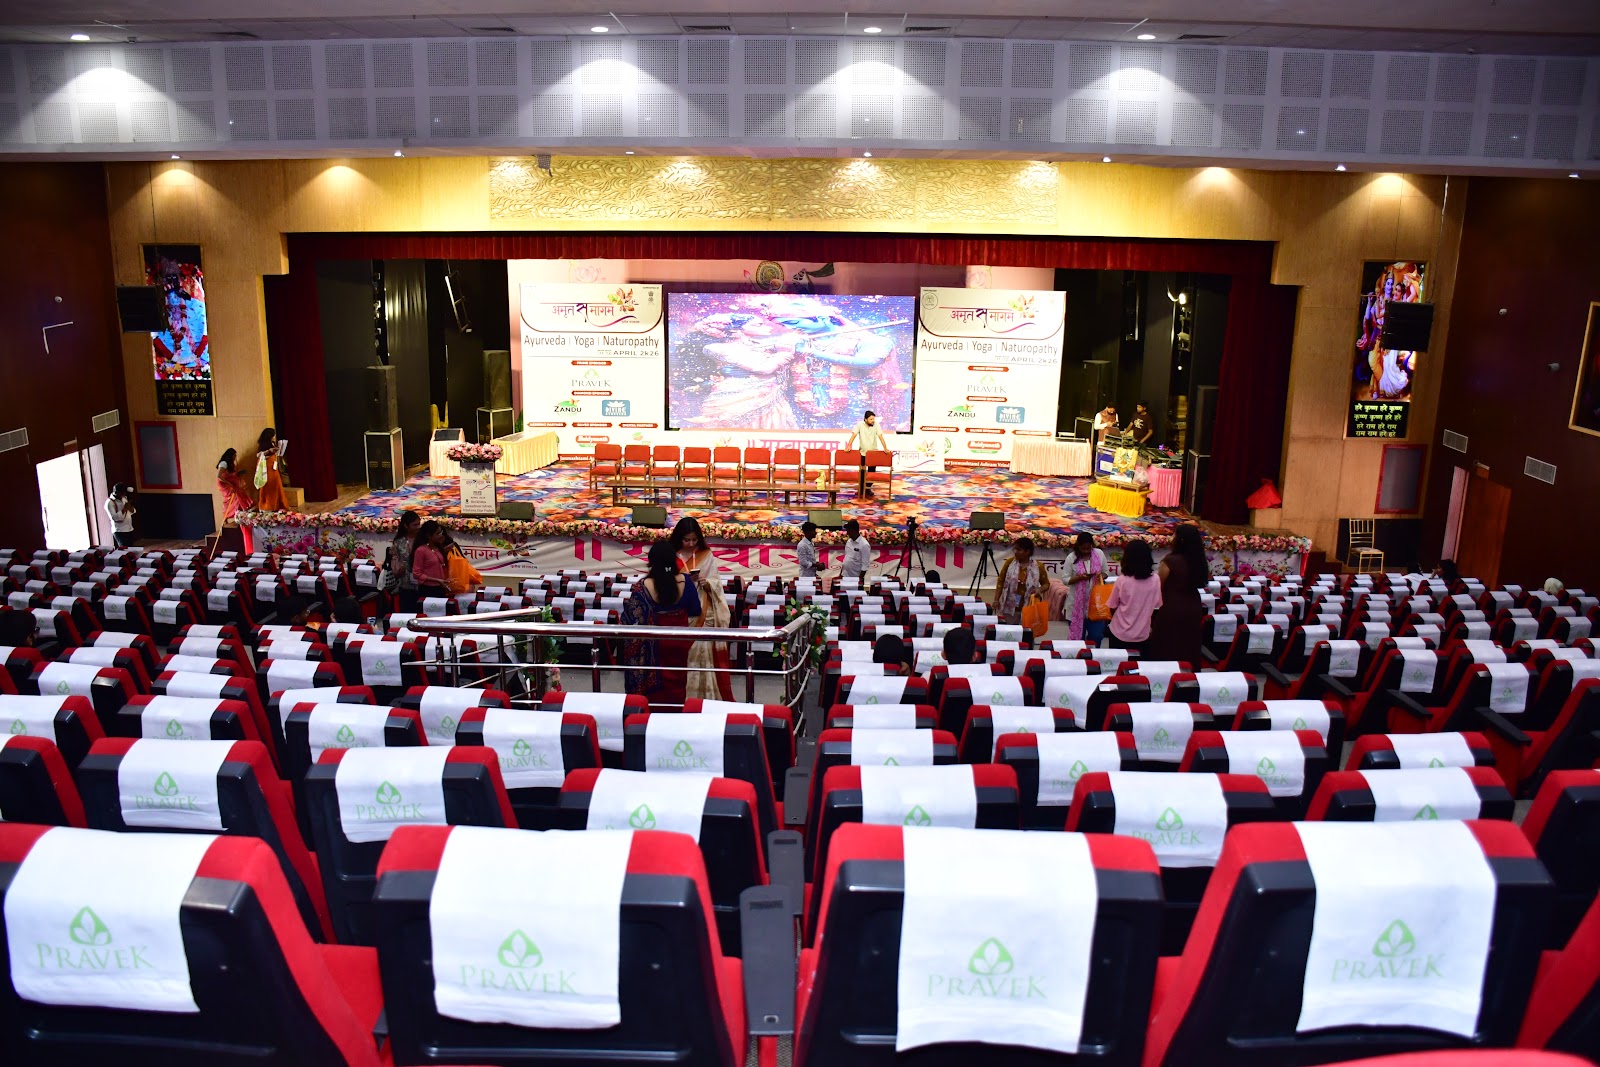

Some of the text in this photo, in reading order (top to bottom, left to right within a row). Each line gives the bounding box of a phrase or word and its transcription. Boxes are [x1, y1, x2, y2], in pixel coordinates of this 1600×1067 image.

[552, 305, 574, 318] अमृत
[950, 310, 974, 323] अमृत
[524, 335, 659, 348] Ayurveda Yoga Naturopathy
[921, 339, 1058, 356] Ayurveda Yoga Naturopathy
[571, 379, 612, 388] PRAVEK
[967, 384, 1007, 394] PRAVEK
[554, 405, 582, 413] ZANDU
[947, 410, 976, 418] ZANDU
[1354, 403, 1363, 411] हरे
[1380, 404, 1388, 412] हरे
[1385, 413, 1393, 421] हरे
[462, 548, 500, 560] मागम
[430, 727, 457, 737] PRAV
[1141, 740, 1178, 750] PRAVEK
[498, 753, 549, 769] PRAVEK
[657, 756, 709, 769] PRAVEK
[135, 795, 198, 810] PRAVEK
[355, 803, 425, 820] PRAVEK
[36, 943, 153, 970] PRAVEK
[1330, 953, 1444, 983] PRAVEK
[460, 964, 579, 995] PRAVEK
[927, 974, 1047, 999] PRAVEK
